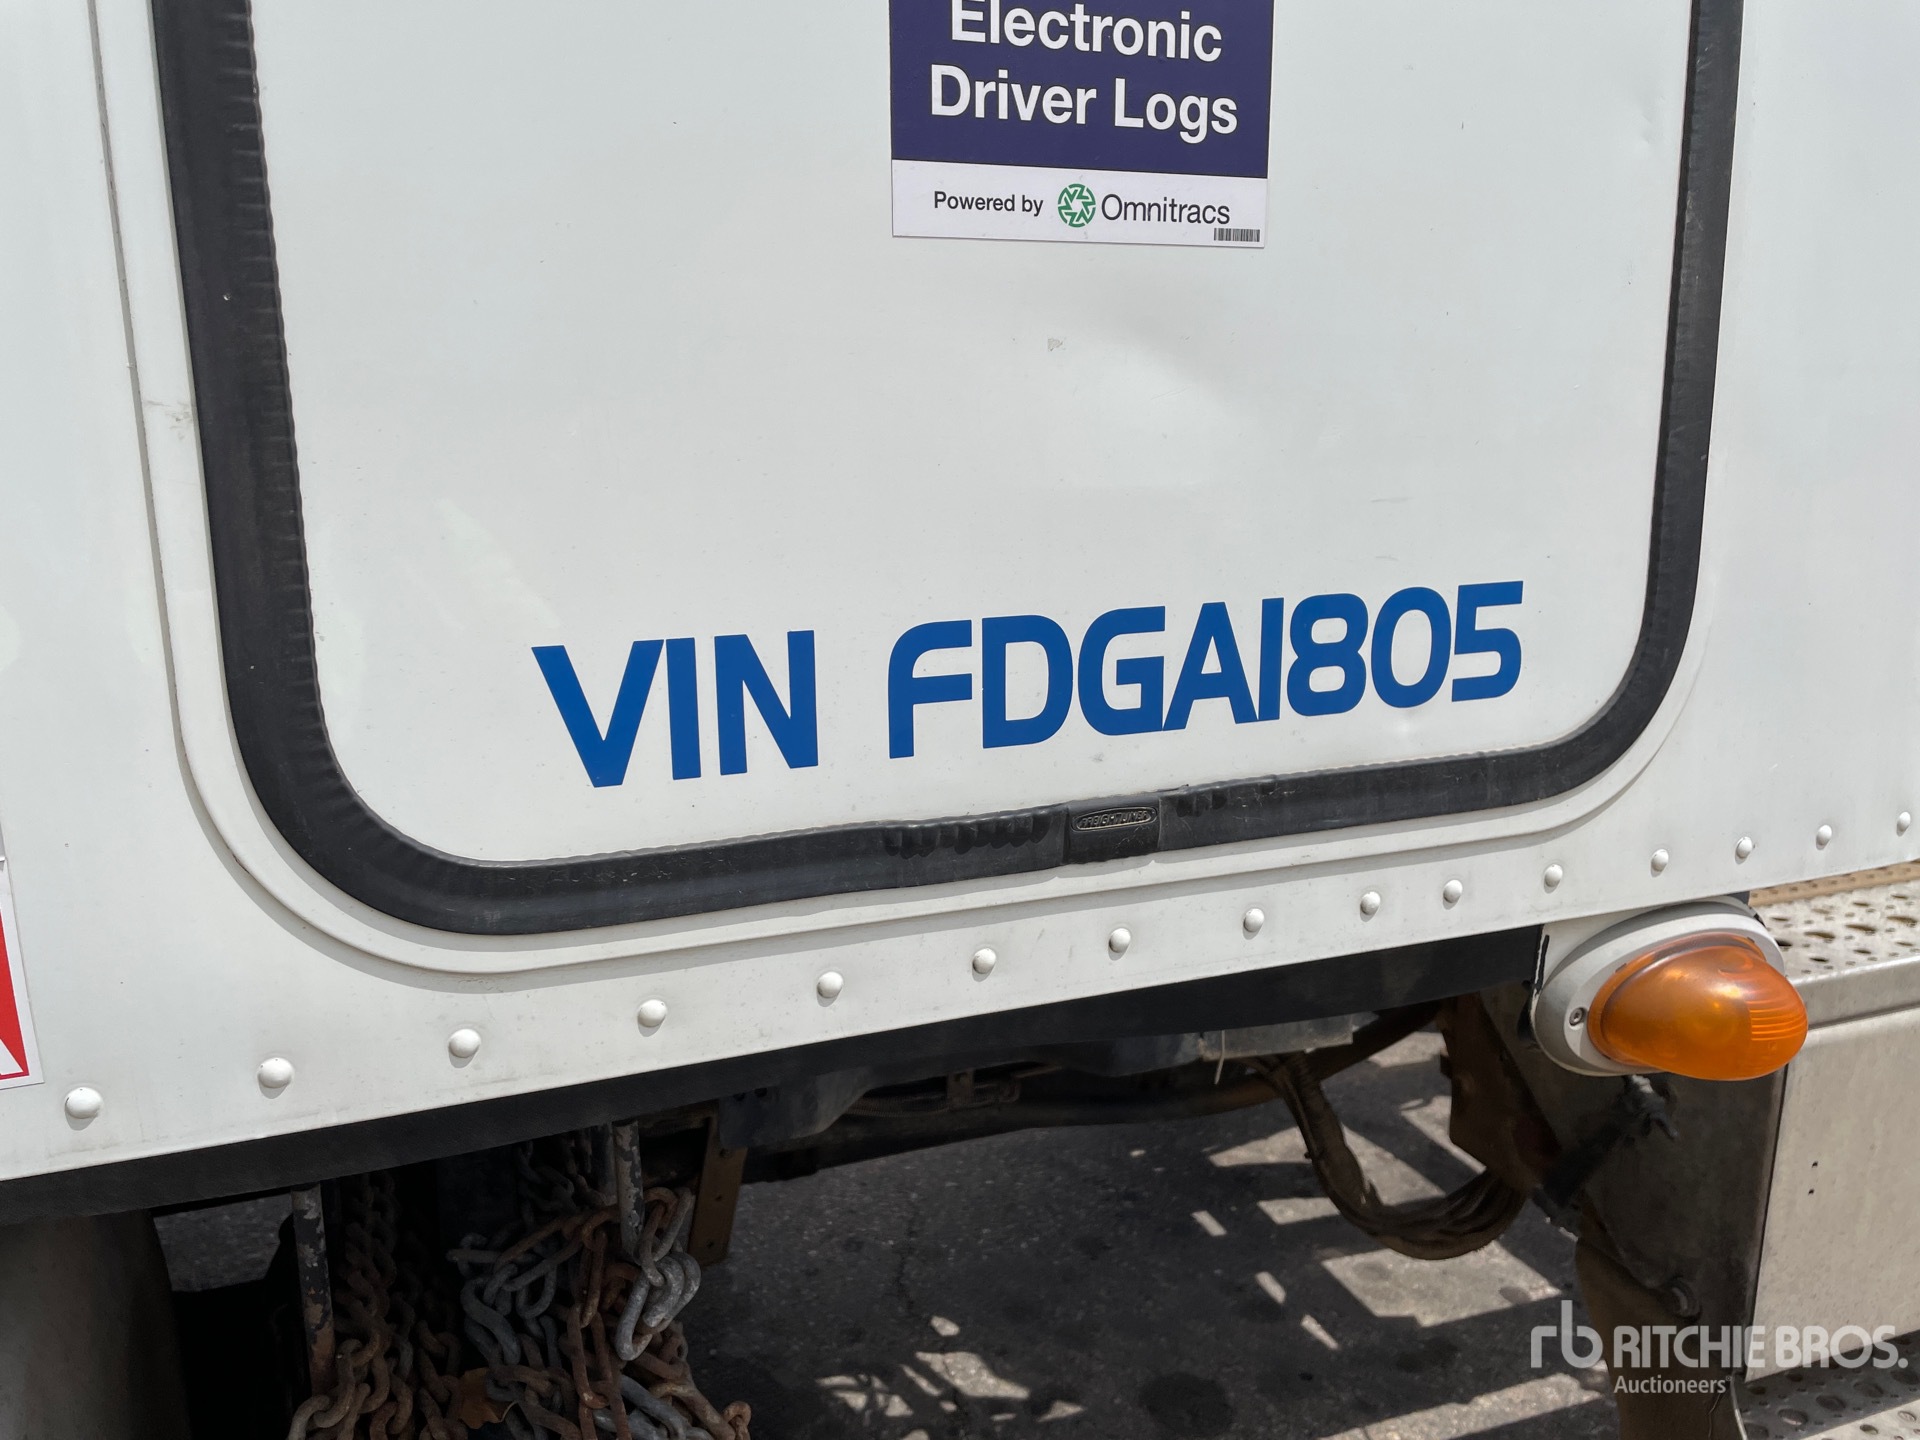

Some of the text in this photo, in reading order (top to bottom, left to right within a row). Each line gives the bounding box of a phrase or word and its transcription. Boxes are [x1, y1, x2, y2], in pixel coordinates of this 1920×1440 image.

[951, 0, 1223, 62] Electronic
[931, 64, 1238, 144] Driver Logs
[934, 190, 1231, 225] Powered by Omnitracs
[533, 631, 817, 787] VIN
